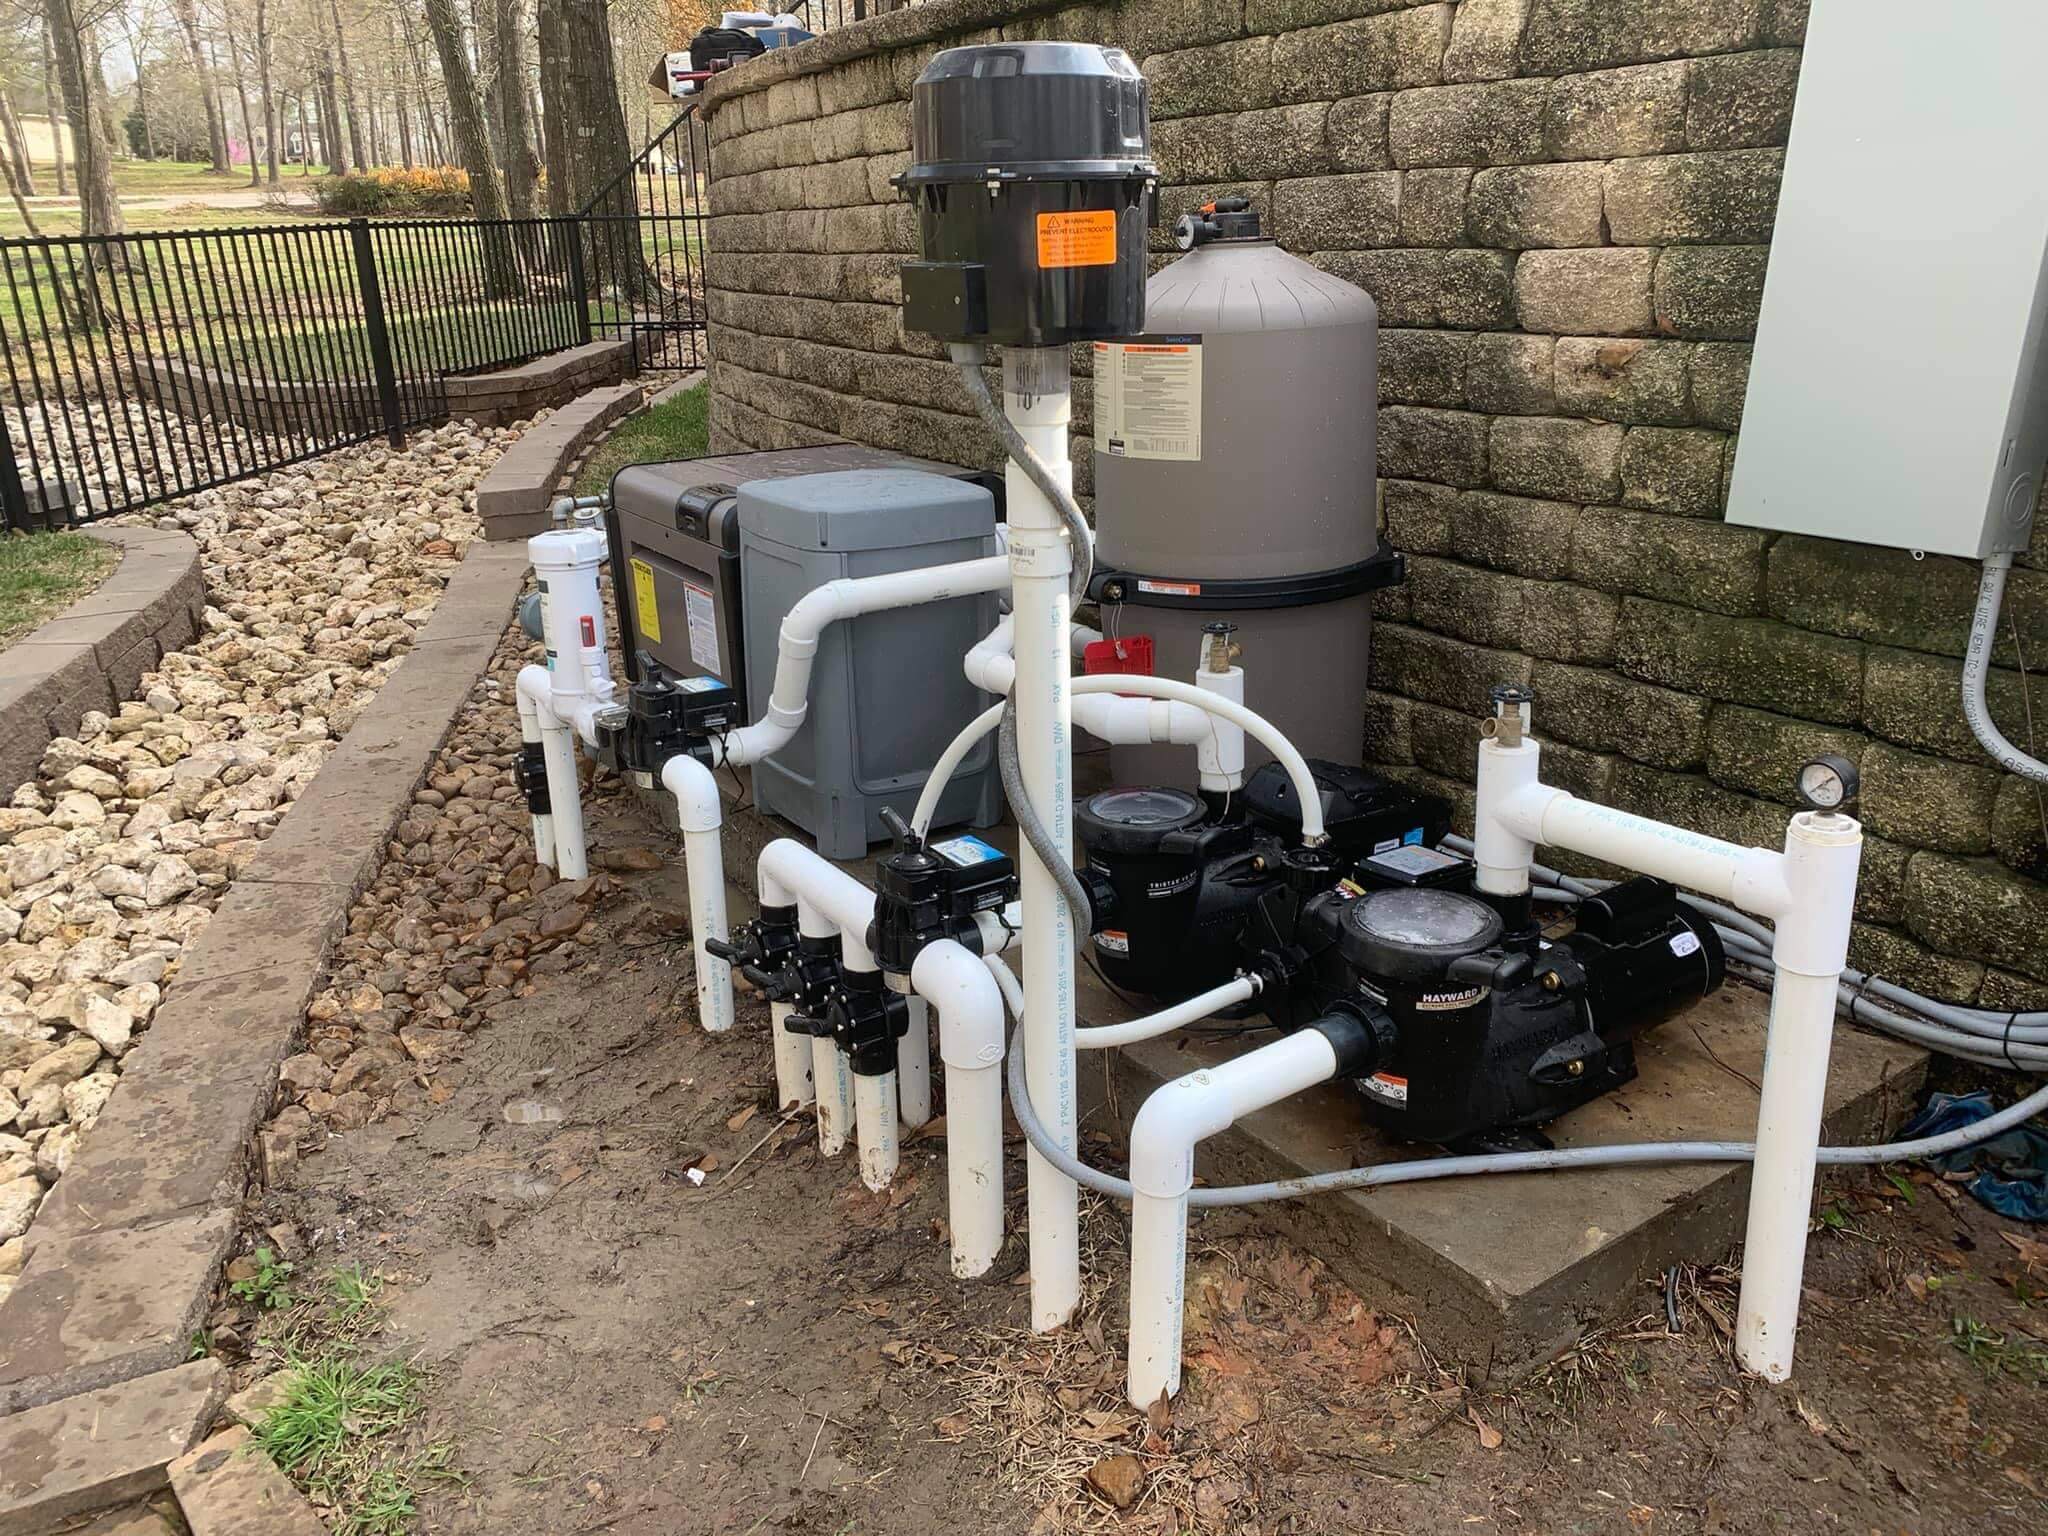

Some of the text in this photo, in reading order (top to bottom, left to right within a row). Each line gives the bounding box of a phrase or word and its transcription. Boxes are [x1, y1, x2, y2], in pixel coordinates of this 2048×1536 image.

[1063, 216, 1095, 224] WARNING
[1040, 227, 1067, 236] PREVENT
[1975, 607, 1990, 629] WIRE
[1422, 987, 1478, 1003] HAYWARD
[1058, 1059, 1068, 1077] SCH
[1059, 1100, 1069, 1118] PVC
